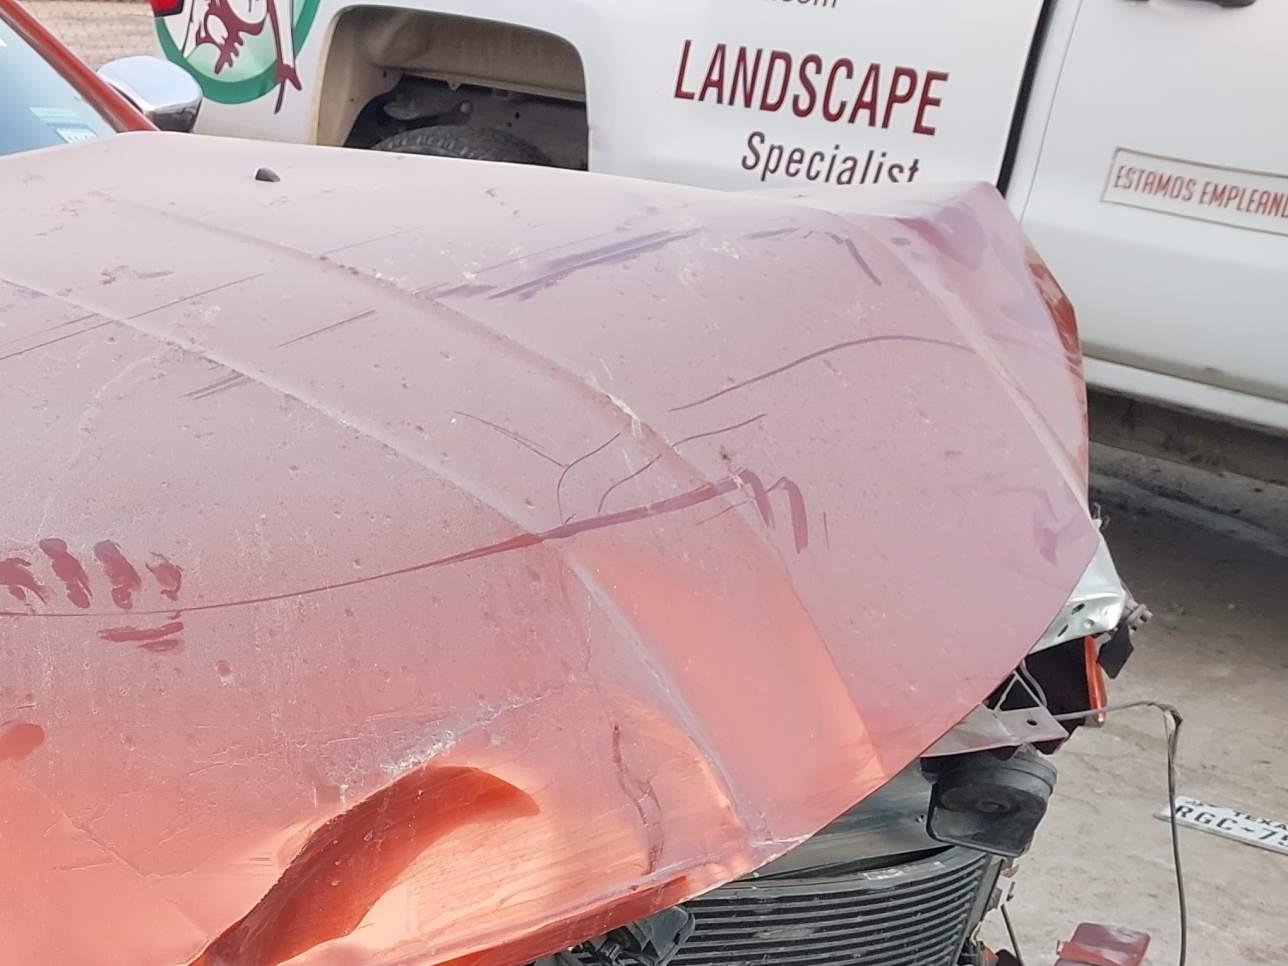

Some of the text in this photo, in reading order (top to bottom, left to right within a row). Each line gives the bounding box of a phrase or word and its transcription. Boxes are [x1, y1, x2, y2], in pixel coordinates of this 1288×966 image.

[674, 39, 950, 136] LANDSCAPE
[741, 131, 920, 185] Specialist
[1114, 164, 1197, 202] ESTAMOS
